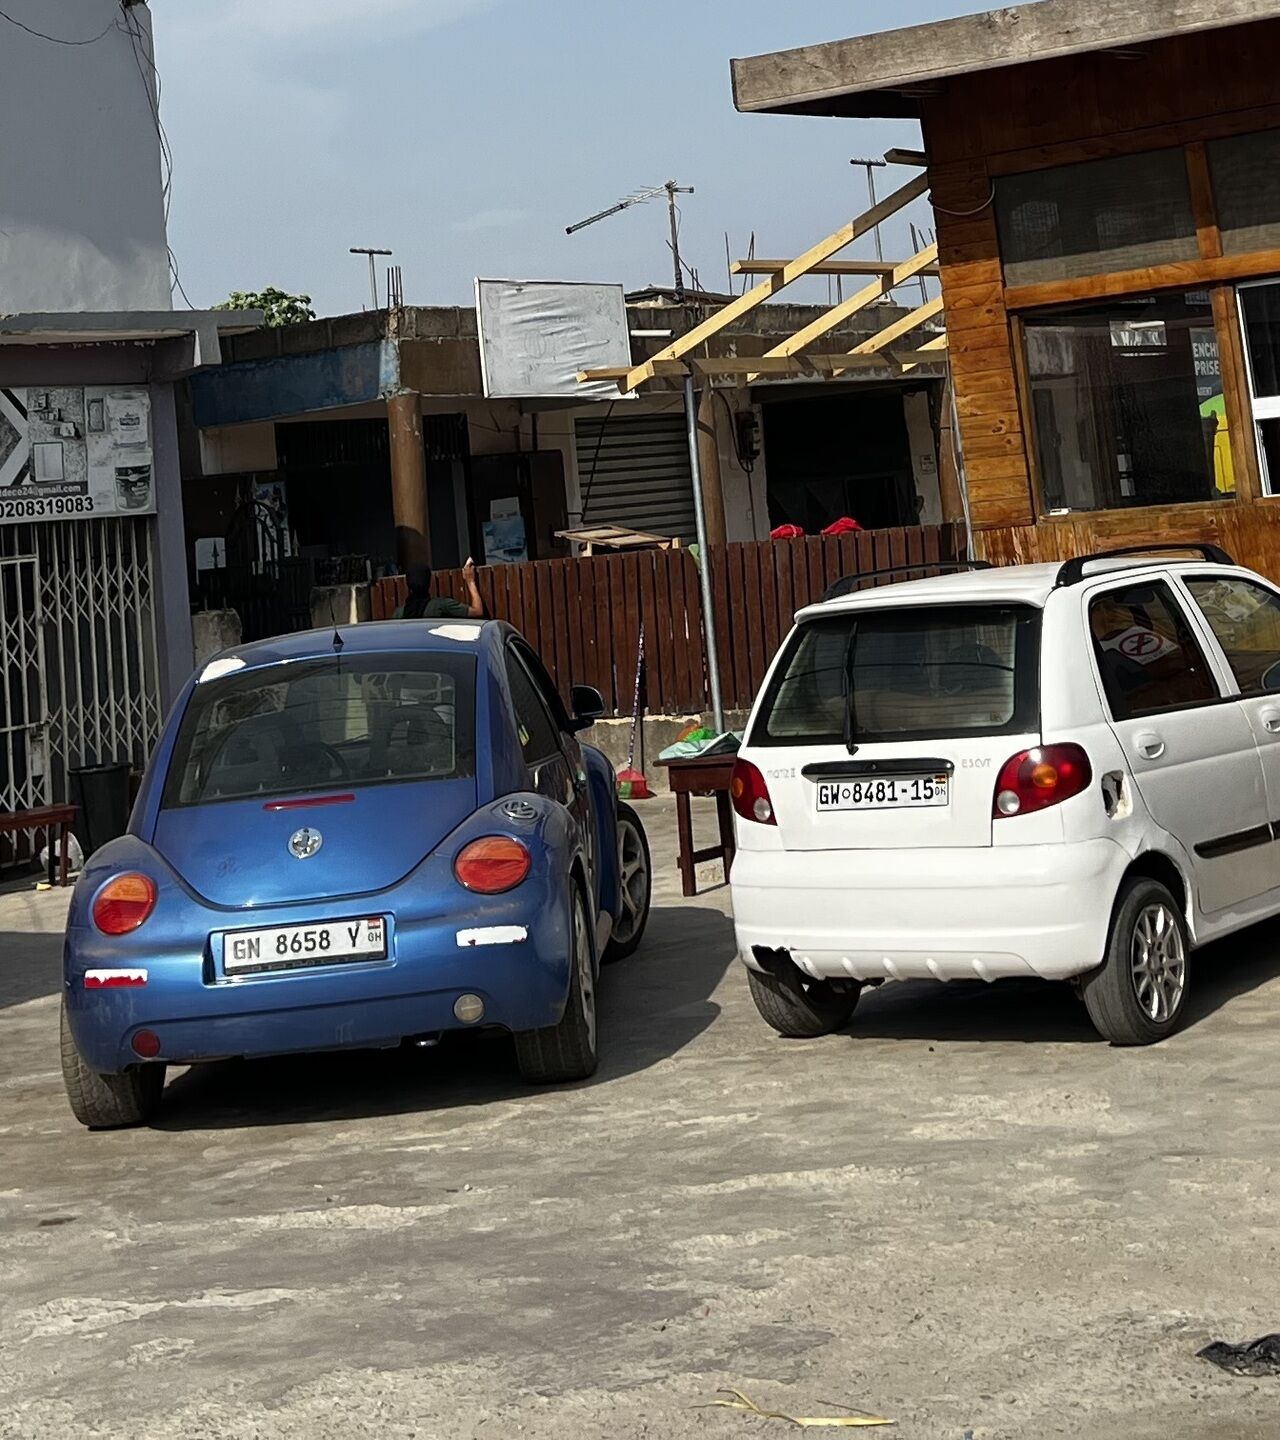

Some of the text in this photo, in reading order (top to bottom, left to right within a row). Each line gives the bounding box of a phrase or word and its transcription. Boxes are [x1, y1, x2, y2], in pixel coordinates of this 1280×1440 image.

[1194, 360, 1221, 377] PRISE
[819, 784, 840, 805] GW
[233, 925, 360, 960] GN 8658 Y
[368, 931, 382, 943] GH
